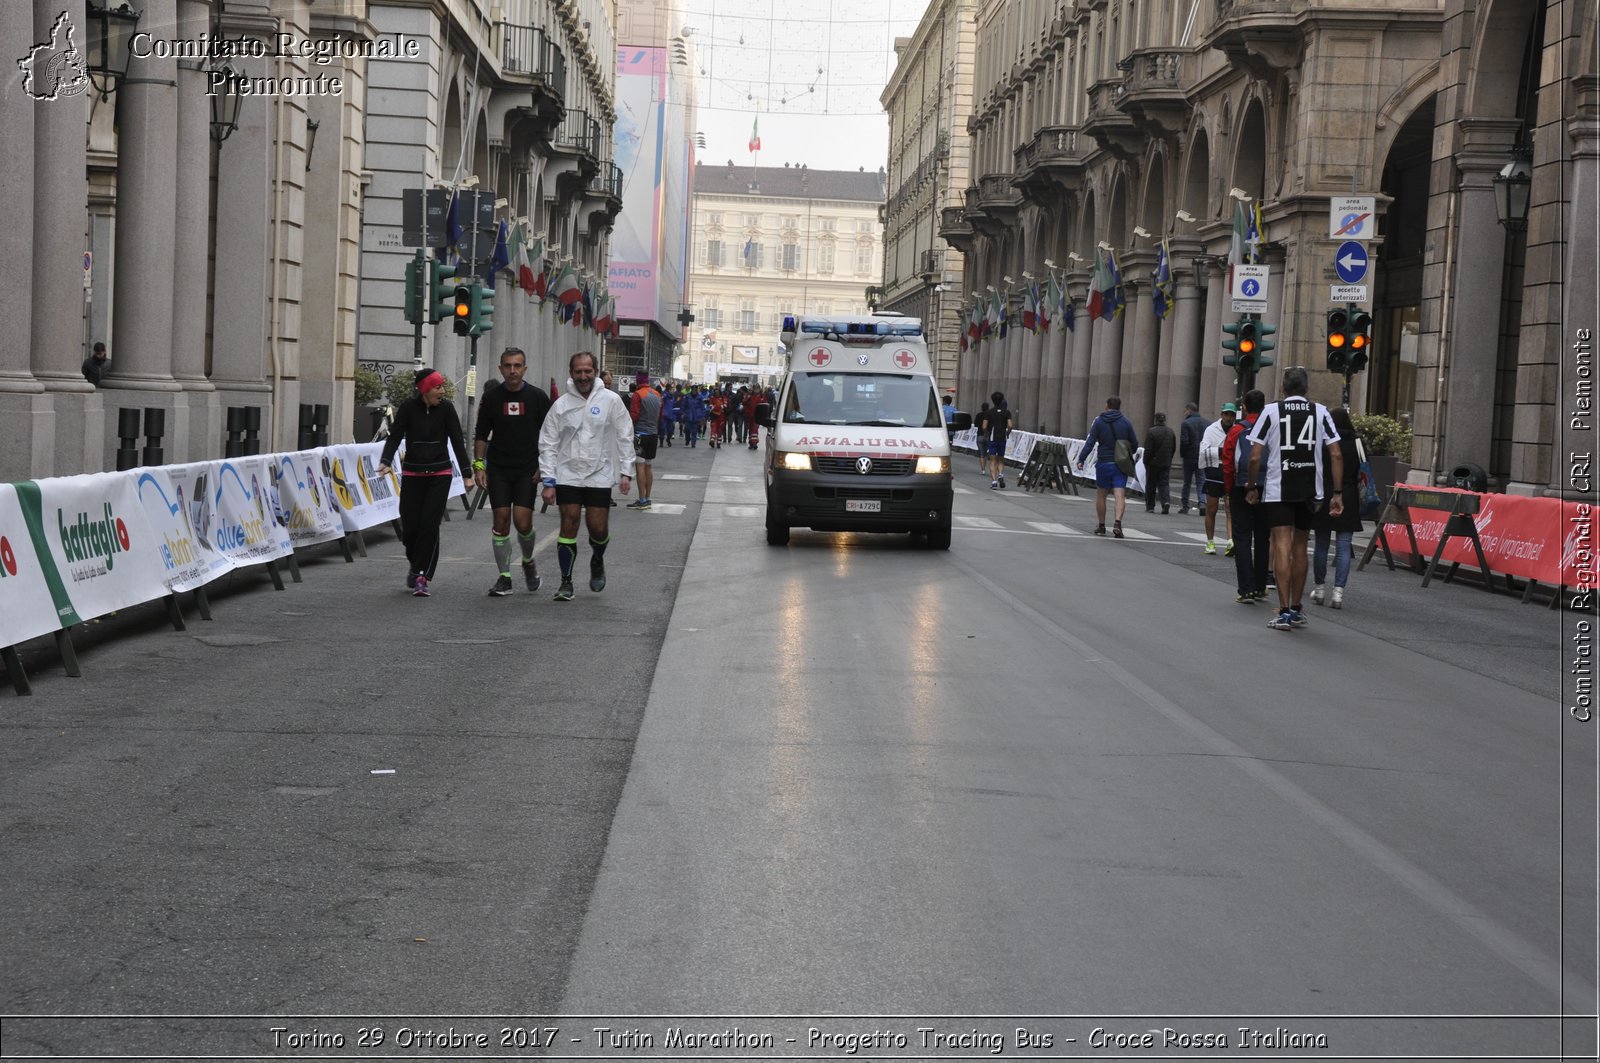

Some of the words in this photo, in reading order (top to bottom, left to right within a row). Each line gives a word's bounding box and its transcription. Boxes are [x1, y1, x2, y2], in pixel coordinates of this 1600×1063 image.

[1338, 204, 1368, 212] pedonale
[608, 268, 651, 278] AFIATO
[609, 281, 637, 289] ZIONI
[1284, 402, 1310, 411] MORGÉ
[1279, 414, 1316, 451] 14
[57, 502, 130, 571] battaglio
